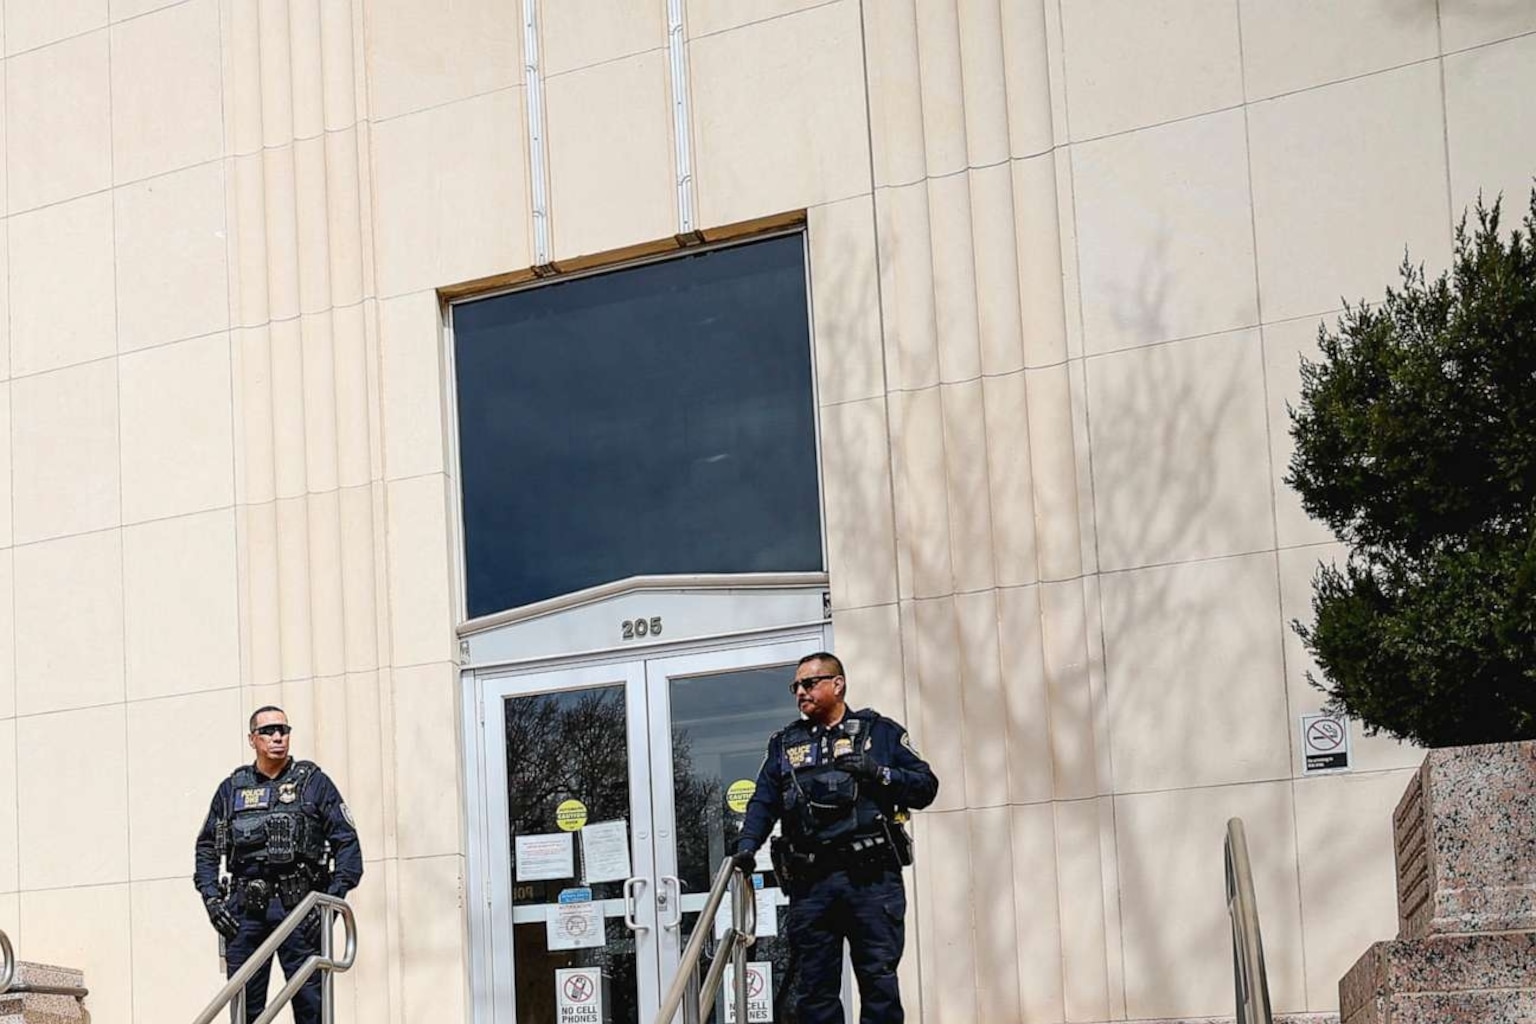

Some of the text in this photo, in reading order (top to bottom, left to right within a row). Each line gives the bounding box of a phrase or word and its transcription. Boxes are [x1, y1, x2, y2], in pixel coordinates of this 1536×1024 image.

[622, 616, 662, 640] 205
[241, 788, 265, 797] POLICE
[561, 1005, 598, 1015] NO CELL
[729, 1010, 768, 1020] PNES
[561, 1014, 598, 1024] PHONES
